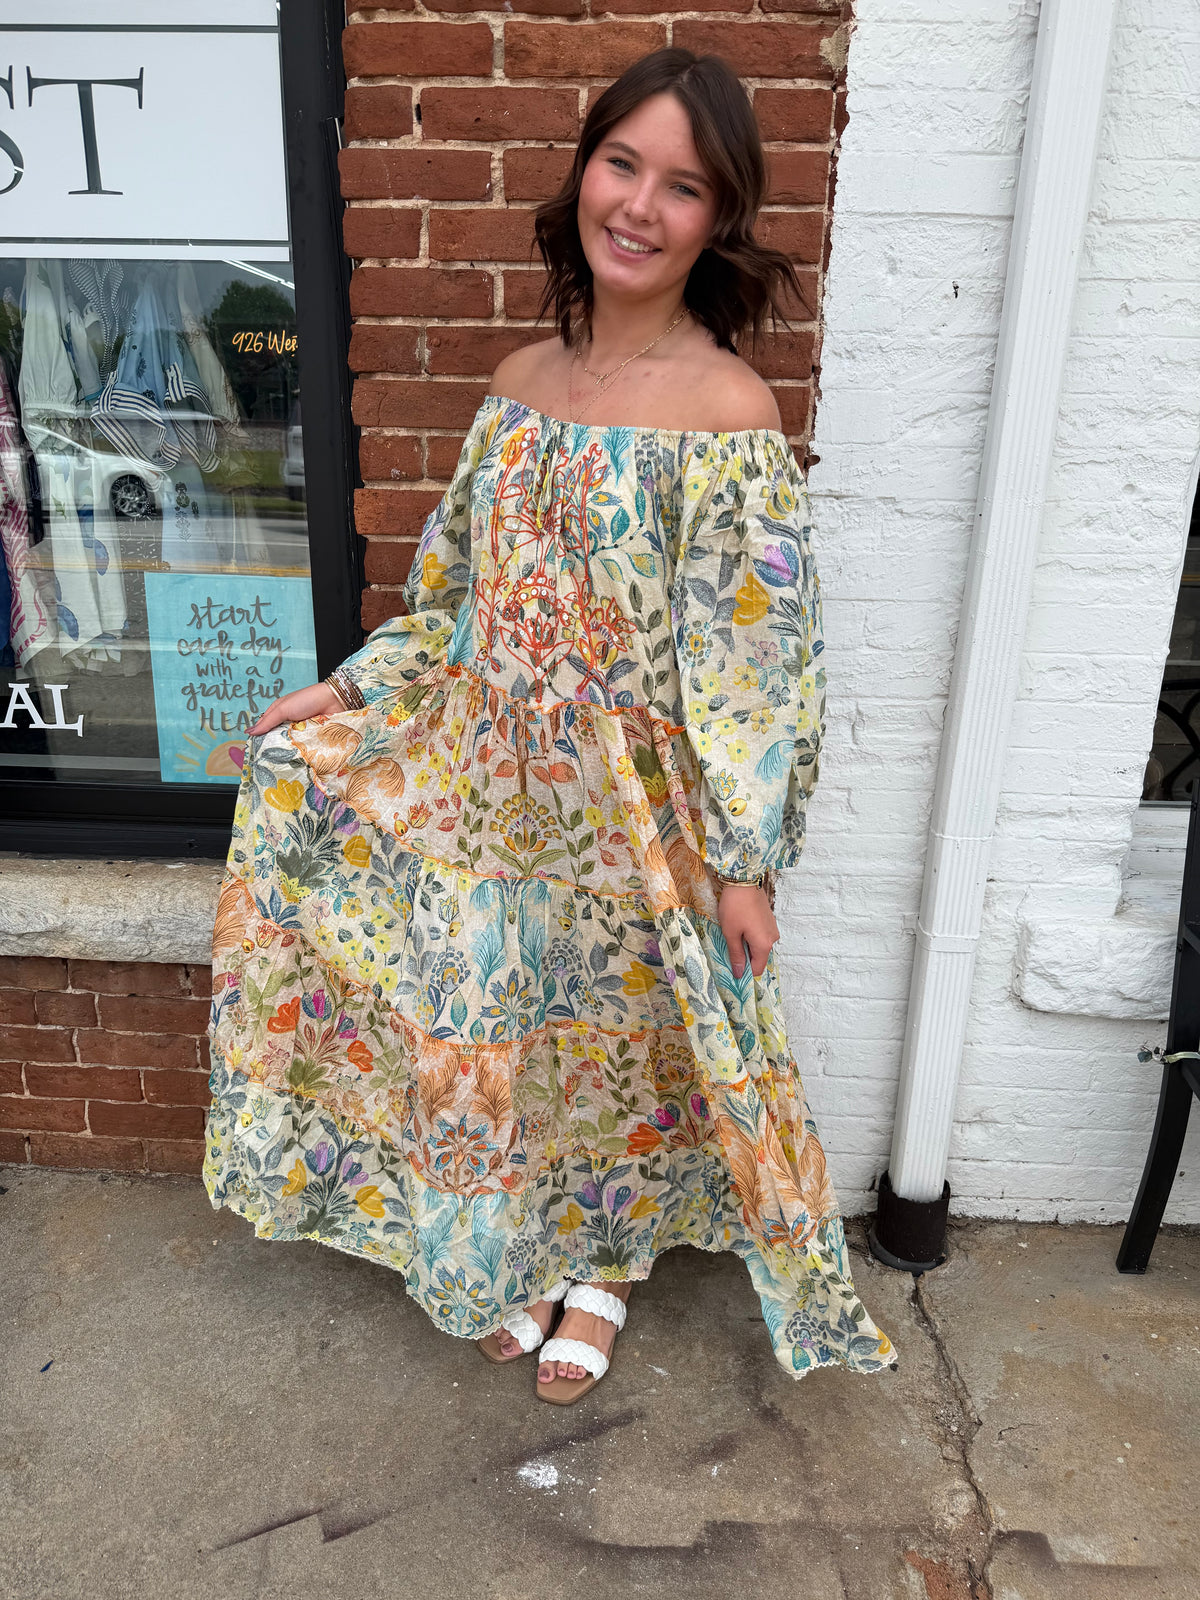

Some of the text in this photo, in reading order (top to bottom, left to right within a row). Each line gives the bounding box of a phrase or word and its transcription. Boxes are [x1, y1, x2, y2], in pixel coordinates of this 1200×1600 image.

[232, 330, 298, 357] 926 Wes
[186, 595, 277, 630] start
[177, 627, 291, 675] each day
[196, 658, 264, 680] with a
[0, 683, 84, 737] AL
[181, 678, 284, 714] grateful
